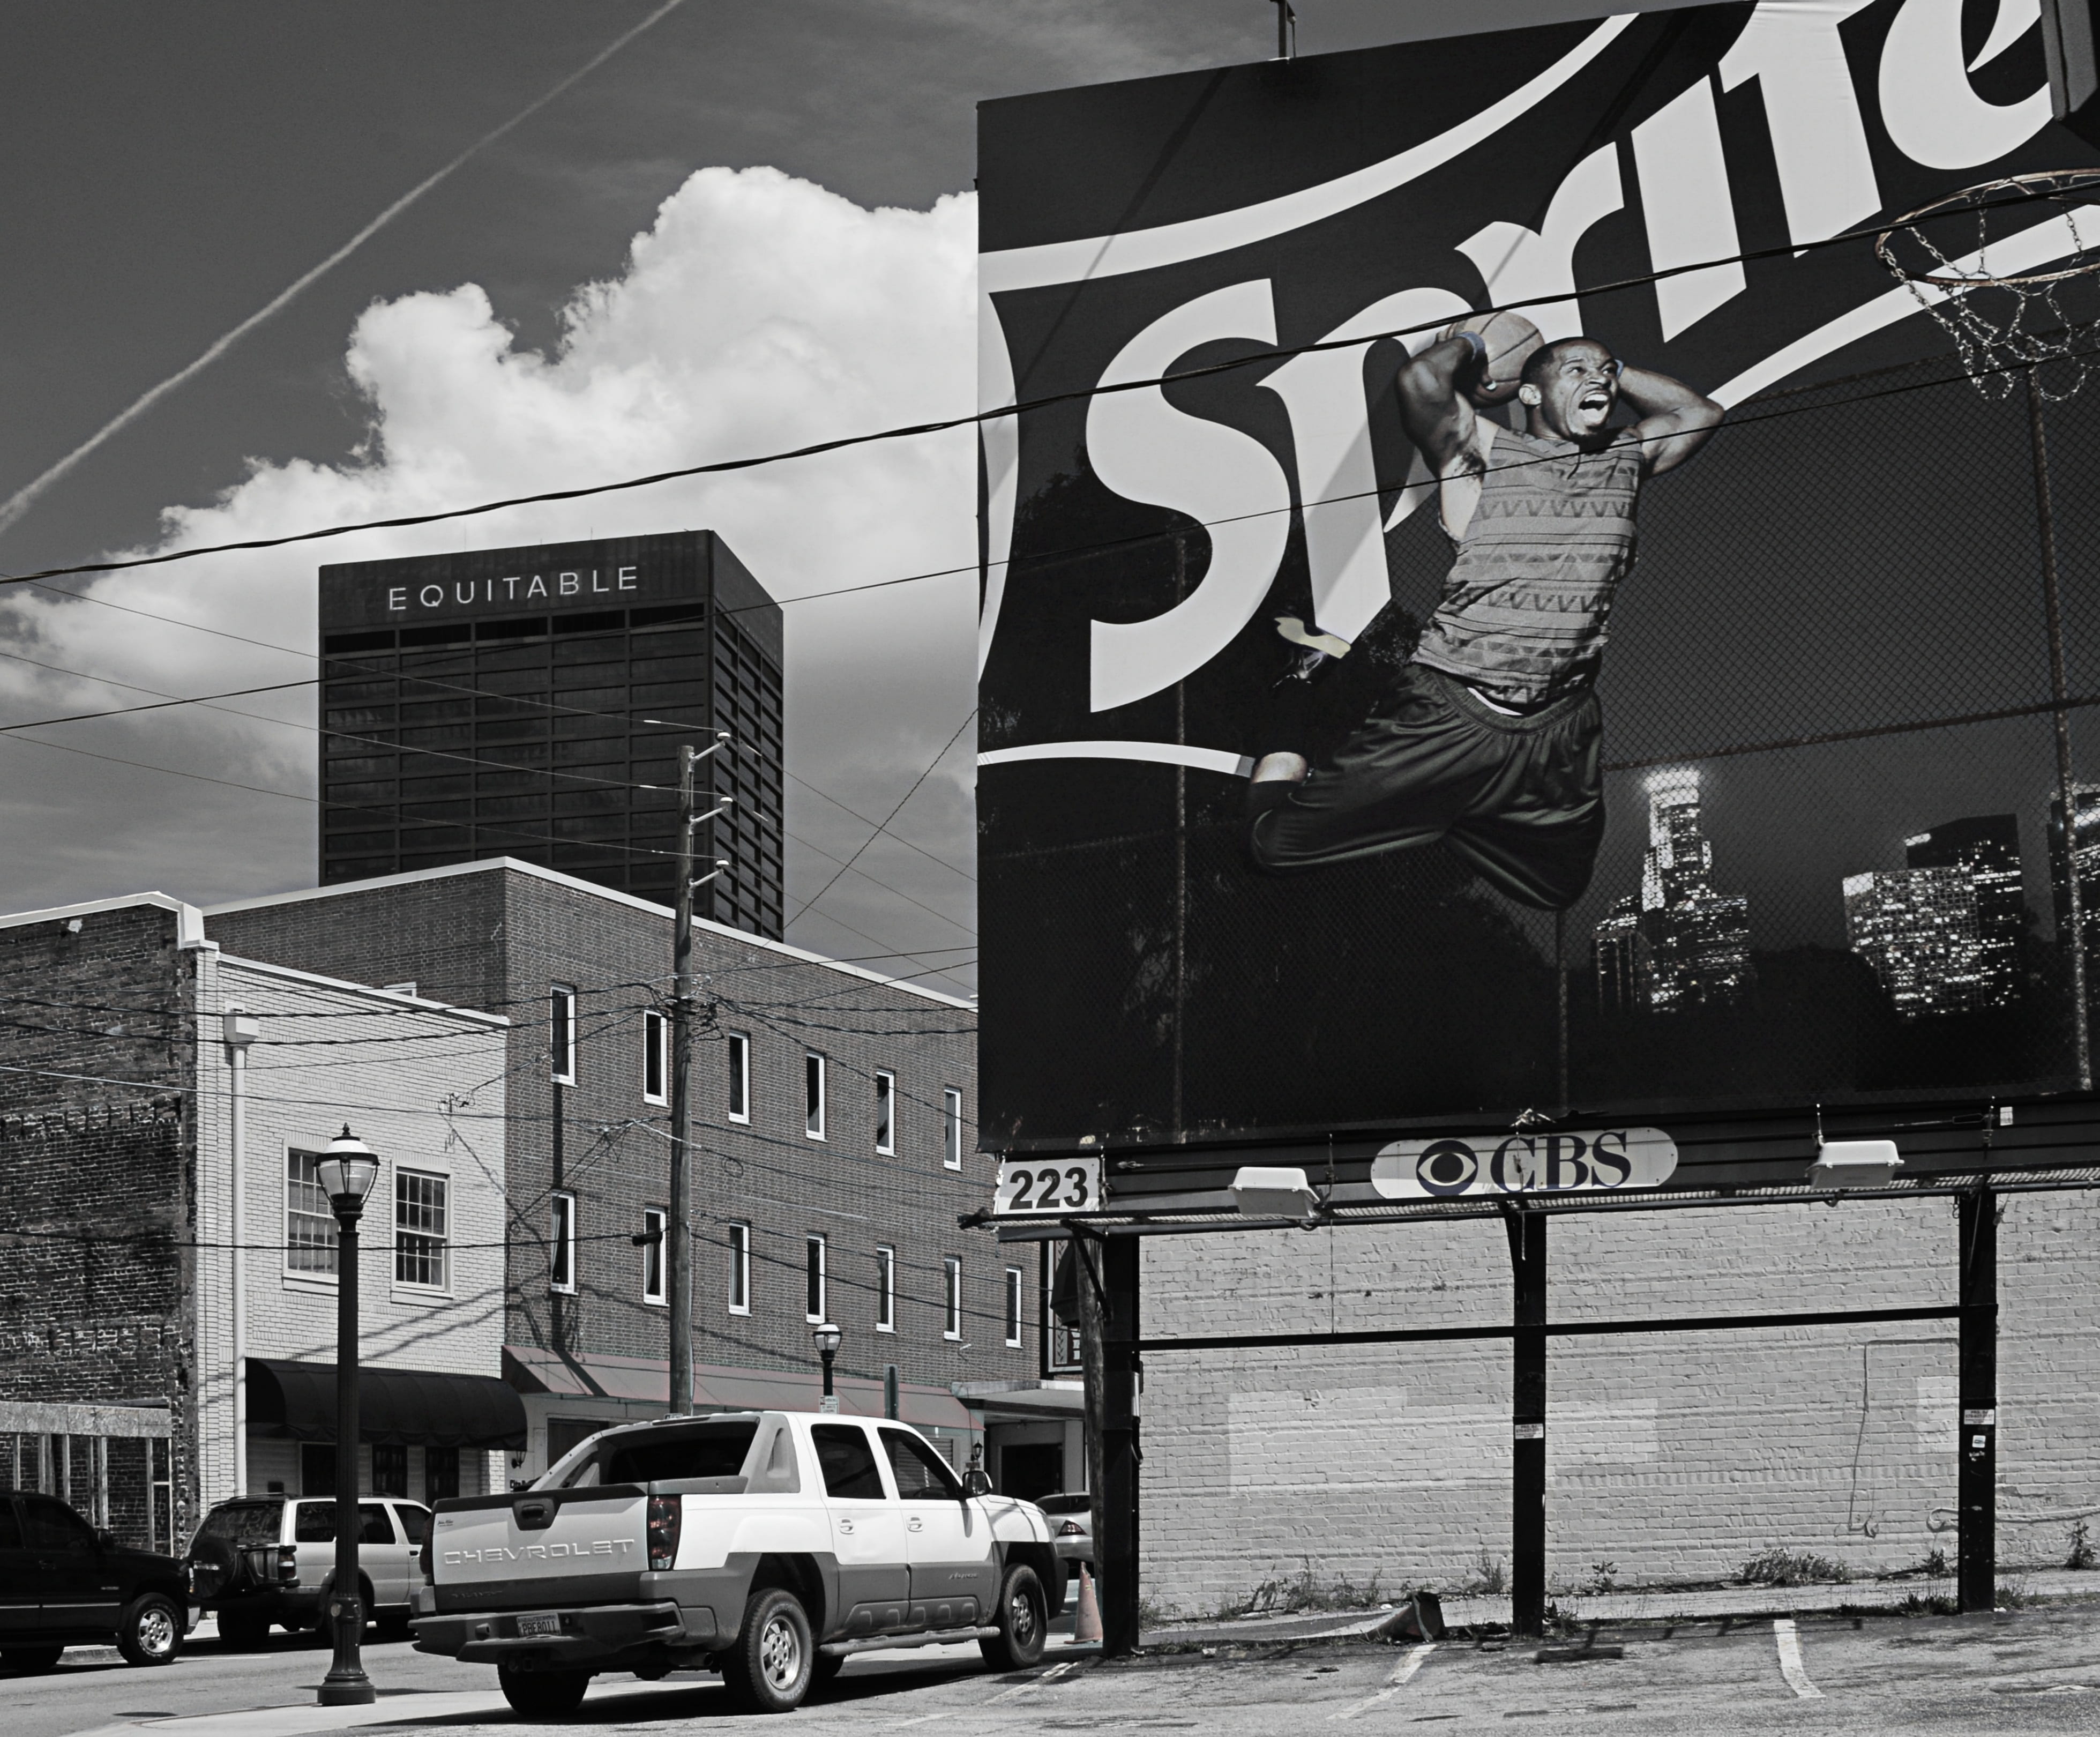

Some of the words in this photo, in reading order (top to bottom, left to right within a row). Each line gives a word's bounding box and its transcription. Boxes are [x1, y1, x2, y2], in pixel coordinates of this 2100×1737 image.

[1086, 0, 2054, 713] Sprite
[389, 566, 637, 610] EQUITABLE
[1490, 1131, 1632, 1192] CBS
[1009, 1166, 1088, 1210] 223
[444, 1539, 635, 1564] CHEVROLET
